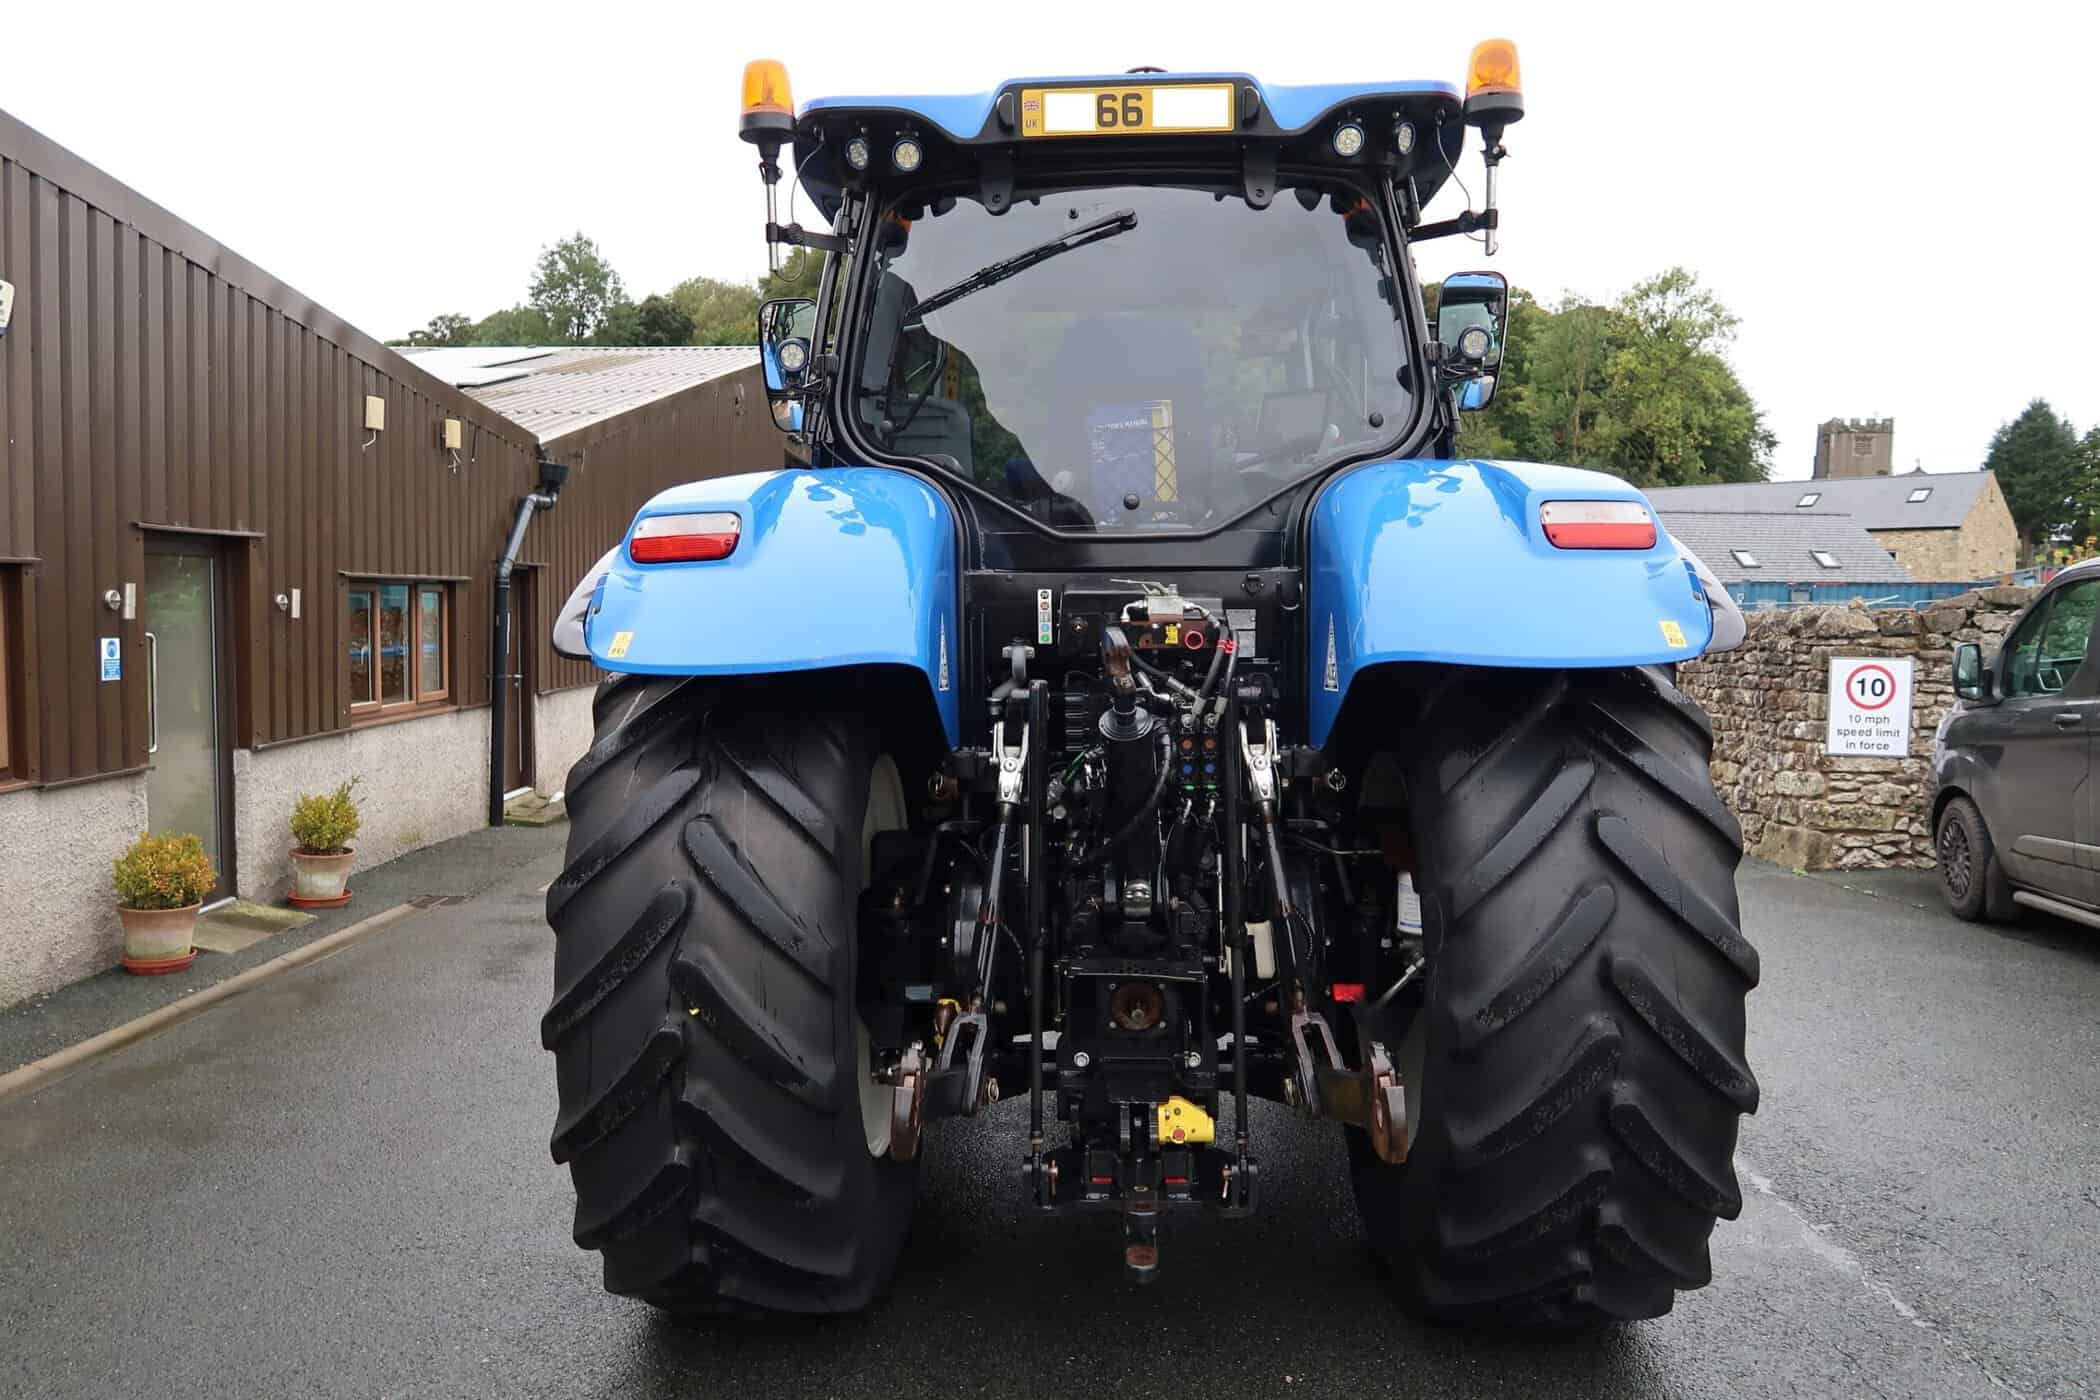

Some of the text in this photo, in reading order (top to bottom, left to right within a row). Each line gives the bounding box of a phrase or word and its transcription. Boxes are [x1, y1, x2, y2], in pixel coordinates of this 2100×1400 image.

[1096, 93, 1143, 127] 66
[1025, 119, 1038, 128] UK
[1856, 678, 1886, 697] 10
[1849, 714, 1890, 725] 10 mph
[1836, 728, 1901, 738] speed limit
[1846, 741, 1890, 750] in force
